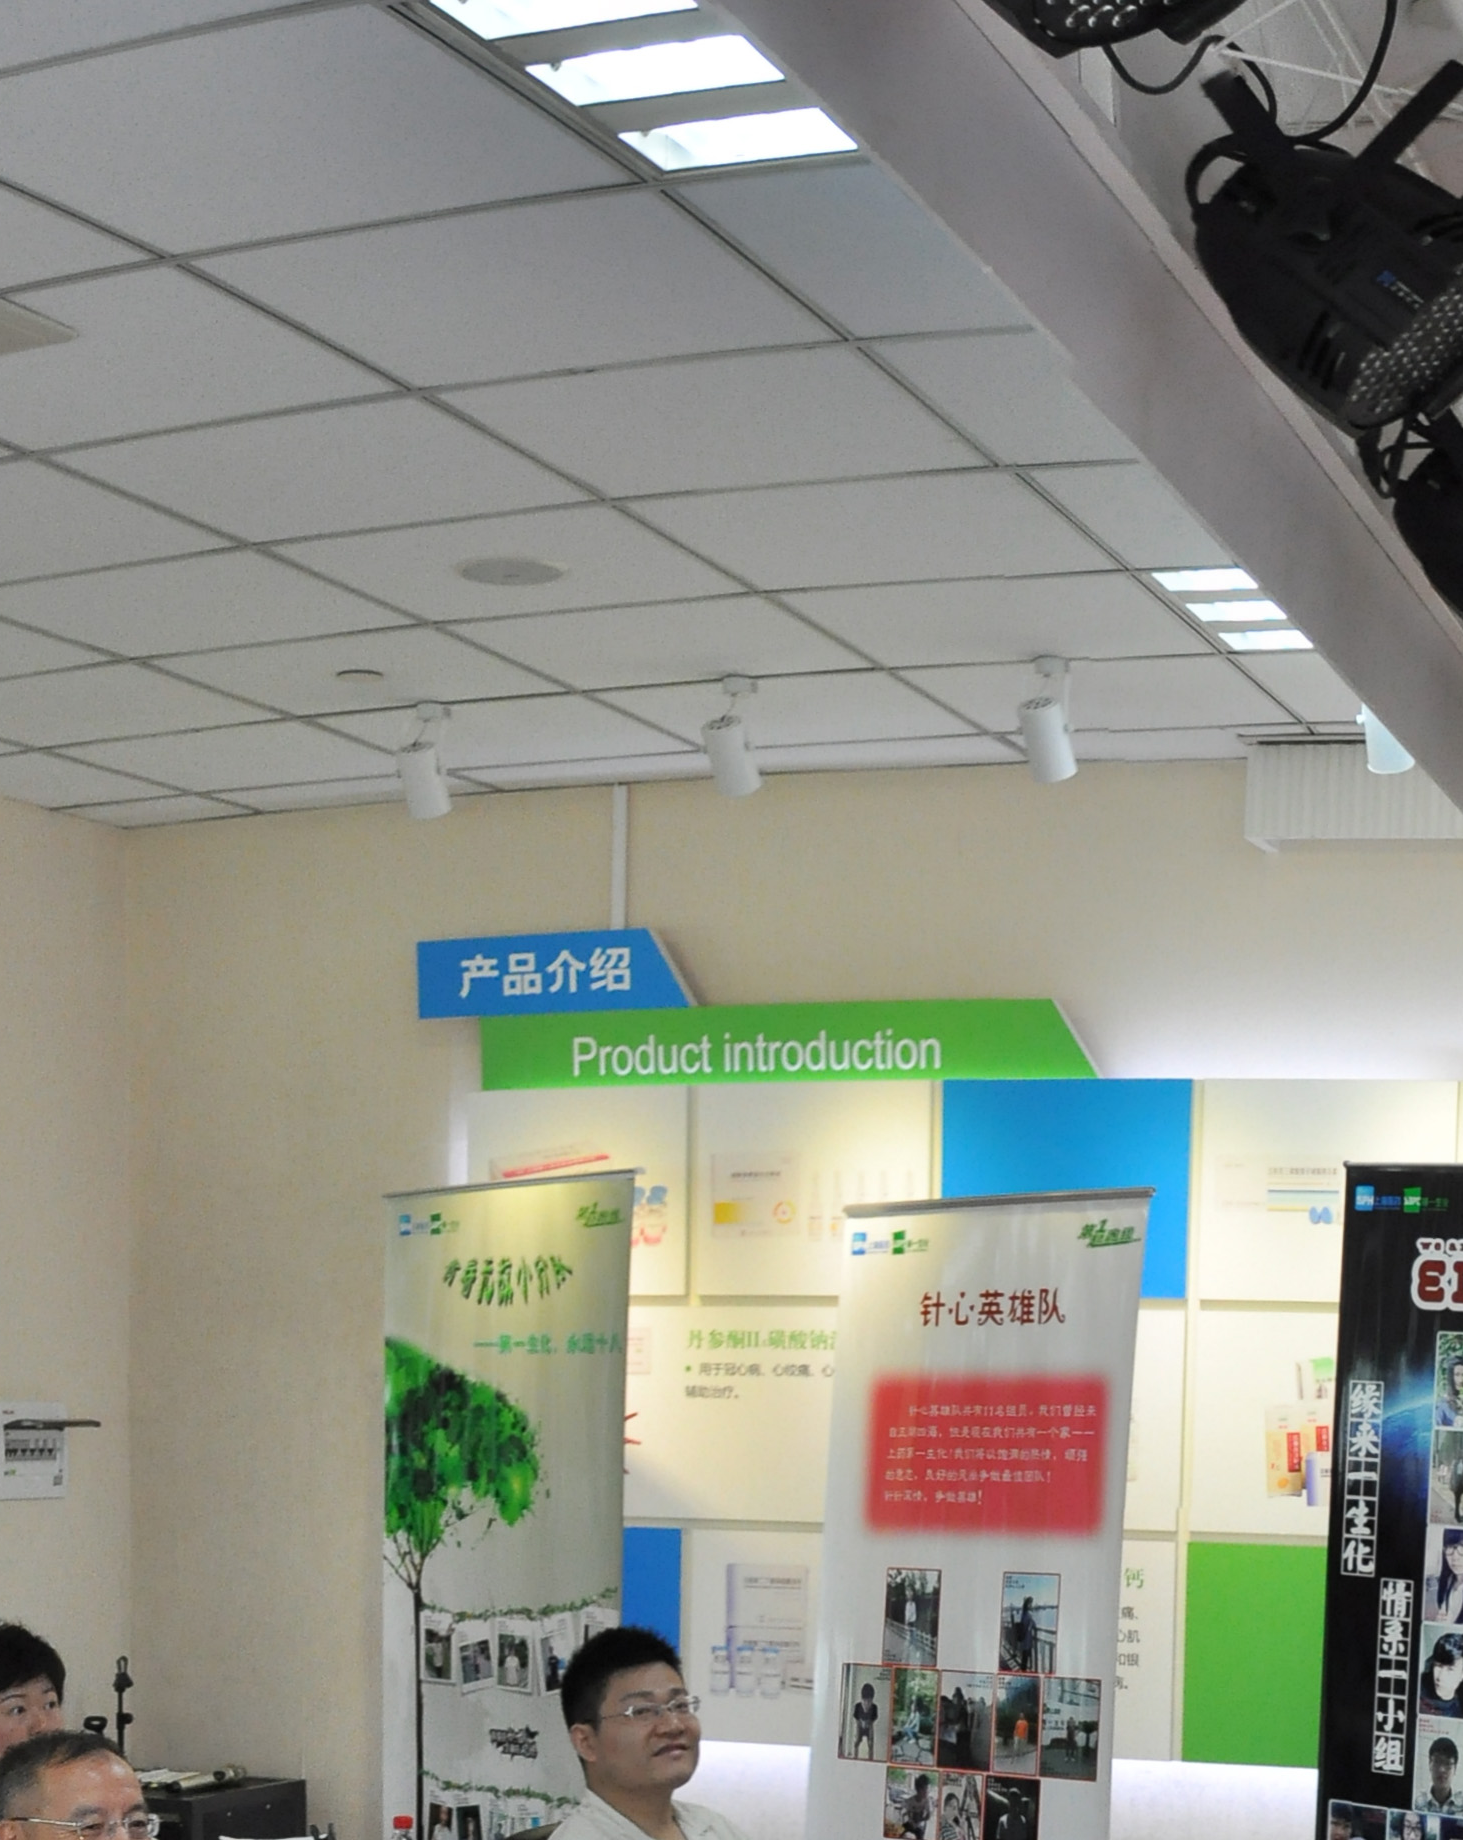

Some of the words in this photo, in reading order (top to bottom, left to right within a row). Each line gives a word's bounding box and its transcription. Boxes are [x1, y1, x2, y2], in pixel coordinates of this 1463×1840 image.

[459, 947, 632, 998] 产品介绍
[572, 1034, 712, 1076] Product
[723, 1029, 941, 1073] introduction
[1419, 1240, 1443, 1254] we
[919, 1287, 1066, 1328] 针心英雄队
[1341, 1382, 1384, 1576] 缘来一生化
[1375, 1580, 1413, 1773] 情系一小组
